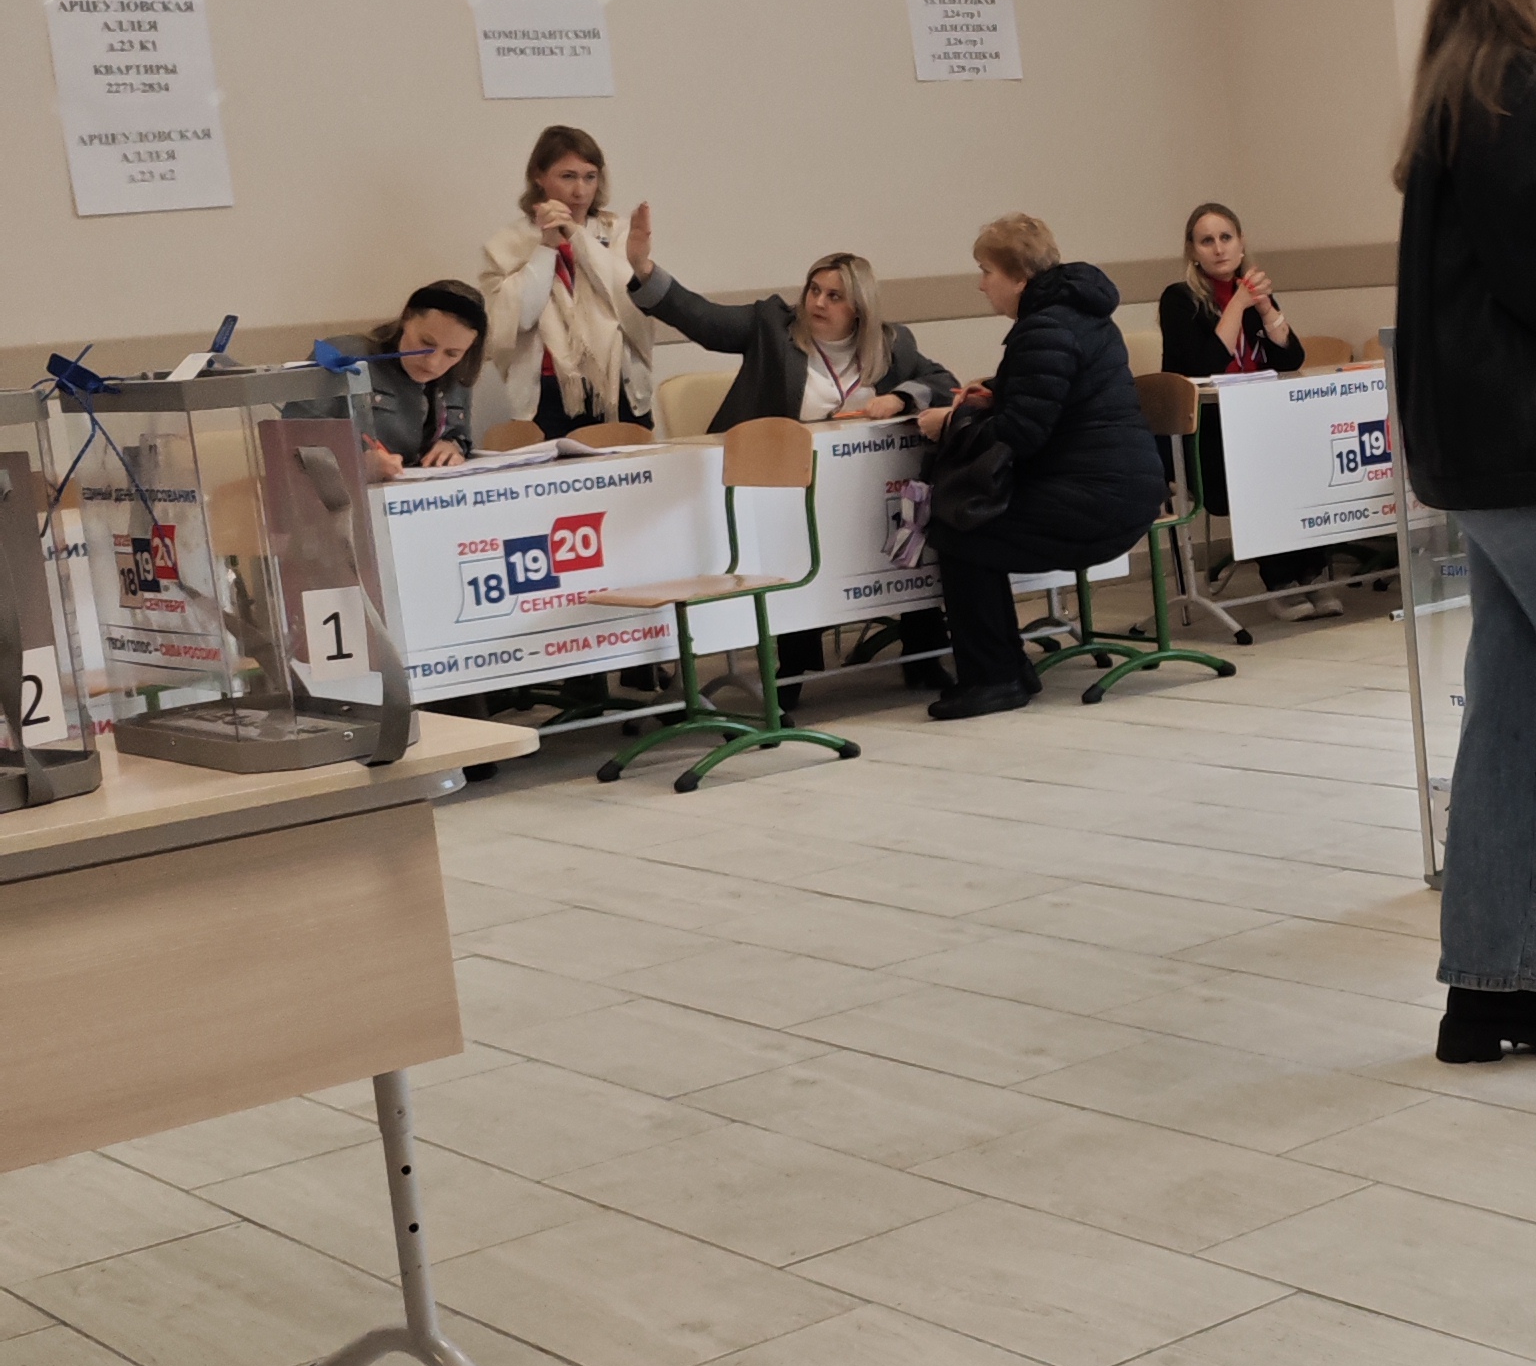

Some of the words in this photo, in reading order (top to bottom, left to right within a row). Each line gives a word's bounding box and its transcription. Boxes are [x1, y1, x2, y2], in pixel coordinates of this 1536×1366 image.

[58, 0, 195, 13] АРЦЕУЛОВСКАЯ
[101, 20, 158, 32] АЛЛЕЯ
[483, 27, 601, 40] КОМЕНДАНТСКИЙ
[495, 46, 565, 57] ПРОСПЕКТ
[93, 63, 178, 76] КВАРТИРЫ
[78, 128, 213, 146] АРЦЕУЛОВСКАЯ
[121, 149, 177, 164] АЛЛЕЯ
[1289, 383, 1338, 402] ЕДИНЫЙ
[1340, 381, 1369, 397] ДЕНЬ
[1330, 422, 1356, 435] 2026
[832, 433, 895, 457] ЕДИНЫЙ
[898, 434, 930, 450] ДЕН
[1335, 449, 1359, 474] 18
[1361, 430, 1386, 456] 19
[1367, 467, 1394, 481] СЕНТ
[386, 489, 468, 517] ЕДИНЫЙ
[472, 486, 520, 506] ДЕНЬ
[524, 470, 653, 498] ГОЛОСОВАНИЯ
[1301, 511, 1331, 529] ТВОЙ
[1333, 507, 1370, 523] ГОЛОС
[1381, 504, 1397, 516] СИ
[457, 538, 500, 556] 2026
[119, 567, 138, 596] 18
[136, 551, 155, 581] 19
[152, 537, 175, 568] 20
[467, 573, 506, 606] 18
[509, 548, 548, 583] 19
[553, 525, 599, 561] 20
[1440, 565, 1471, 576] ЕДИН
[843, 579, 883, 601] ТВОЙ
[886, 573, 934, 594] ГОЛОС
[520, 588, 605, 613] СЕНТЯБ
[322, 611, 353, 661] 1
[404, 657, 459, 679] ТВОЙ
[463, 648, 524, 671] ГОЛОС
[544, 635, 593, 656] СИЛА
[596, 623, 670, 648] РОССИИ!
[22, 674, 50, 727] 2
[1449, 695, 1465, 706] ТВ
